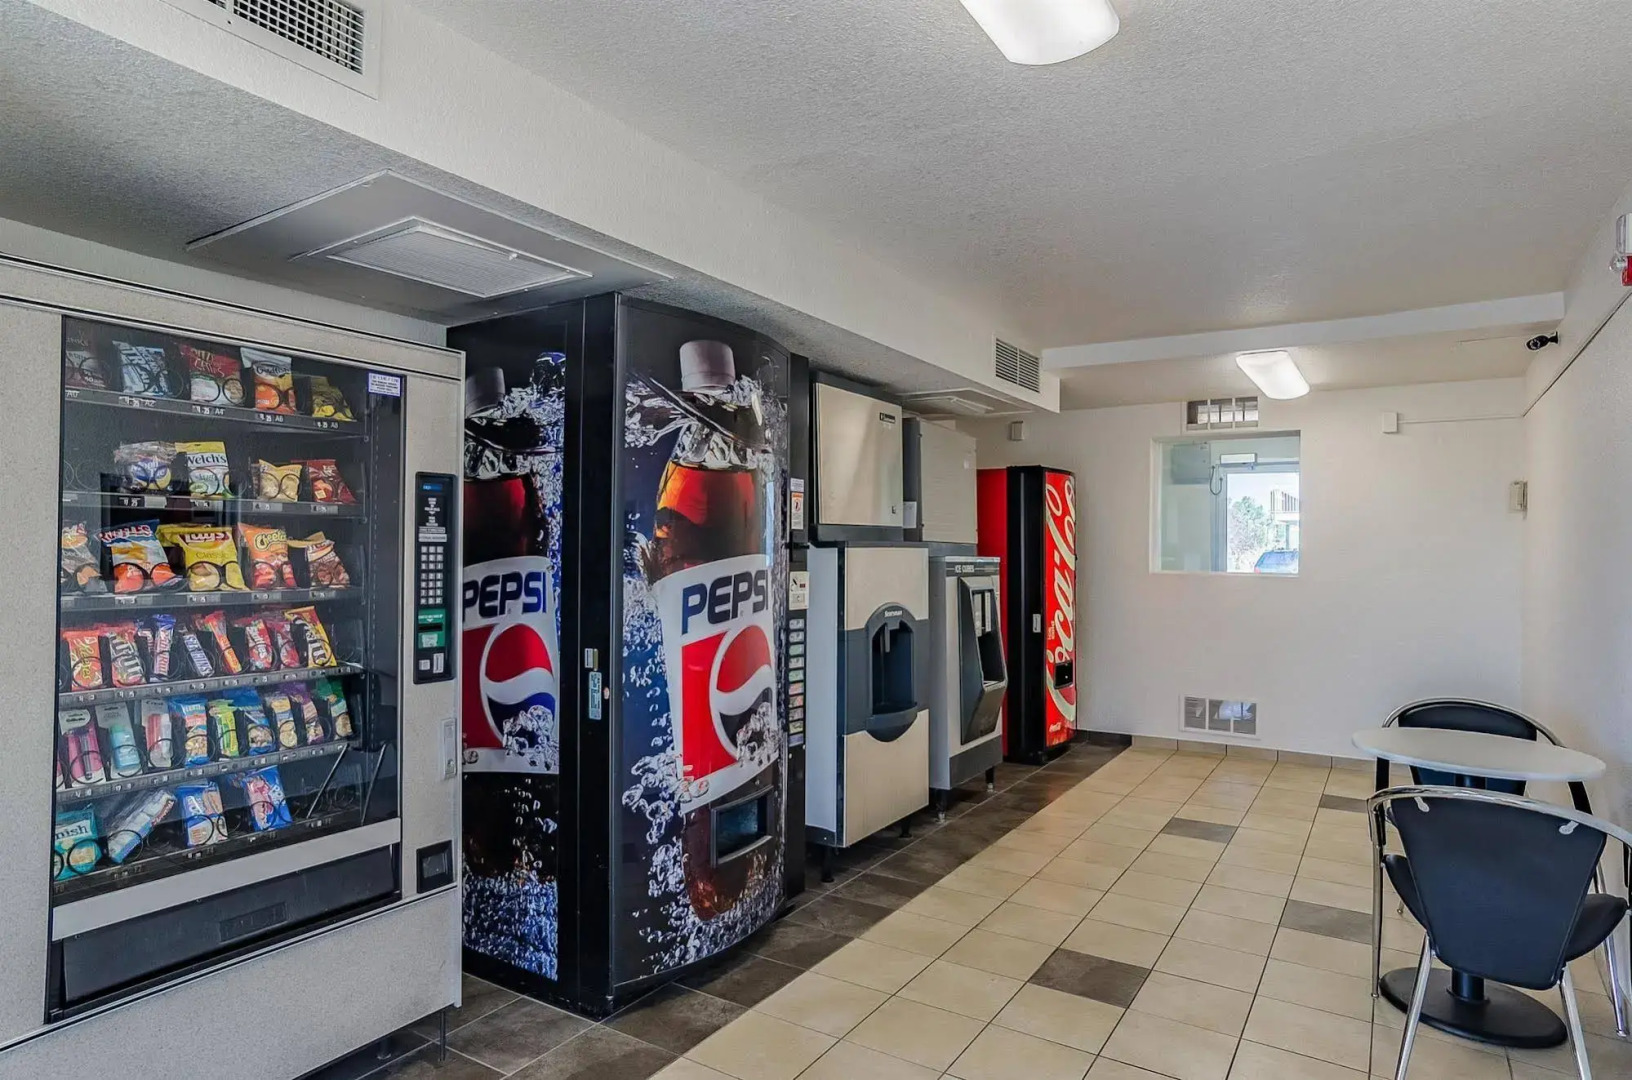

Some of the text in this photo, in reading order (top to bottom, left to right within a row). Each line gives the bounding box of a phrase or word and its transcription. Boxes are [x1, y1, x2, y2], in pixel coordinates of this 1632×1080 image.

[463, 570, 546, 623] PEPSI
[681, 569, 769, 636] PEPSI
[1045, 474, 1076, 722] Coca-Col
